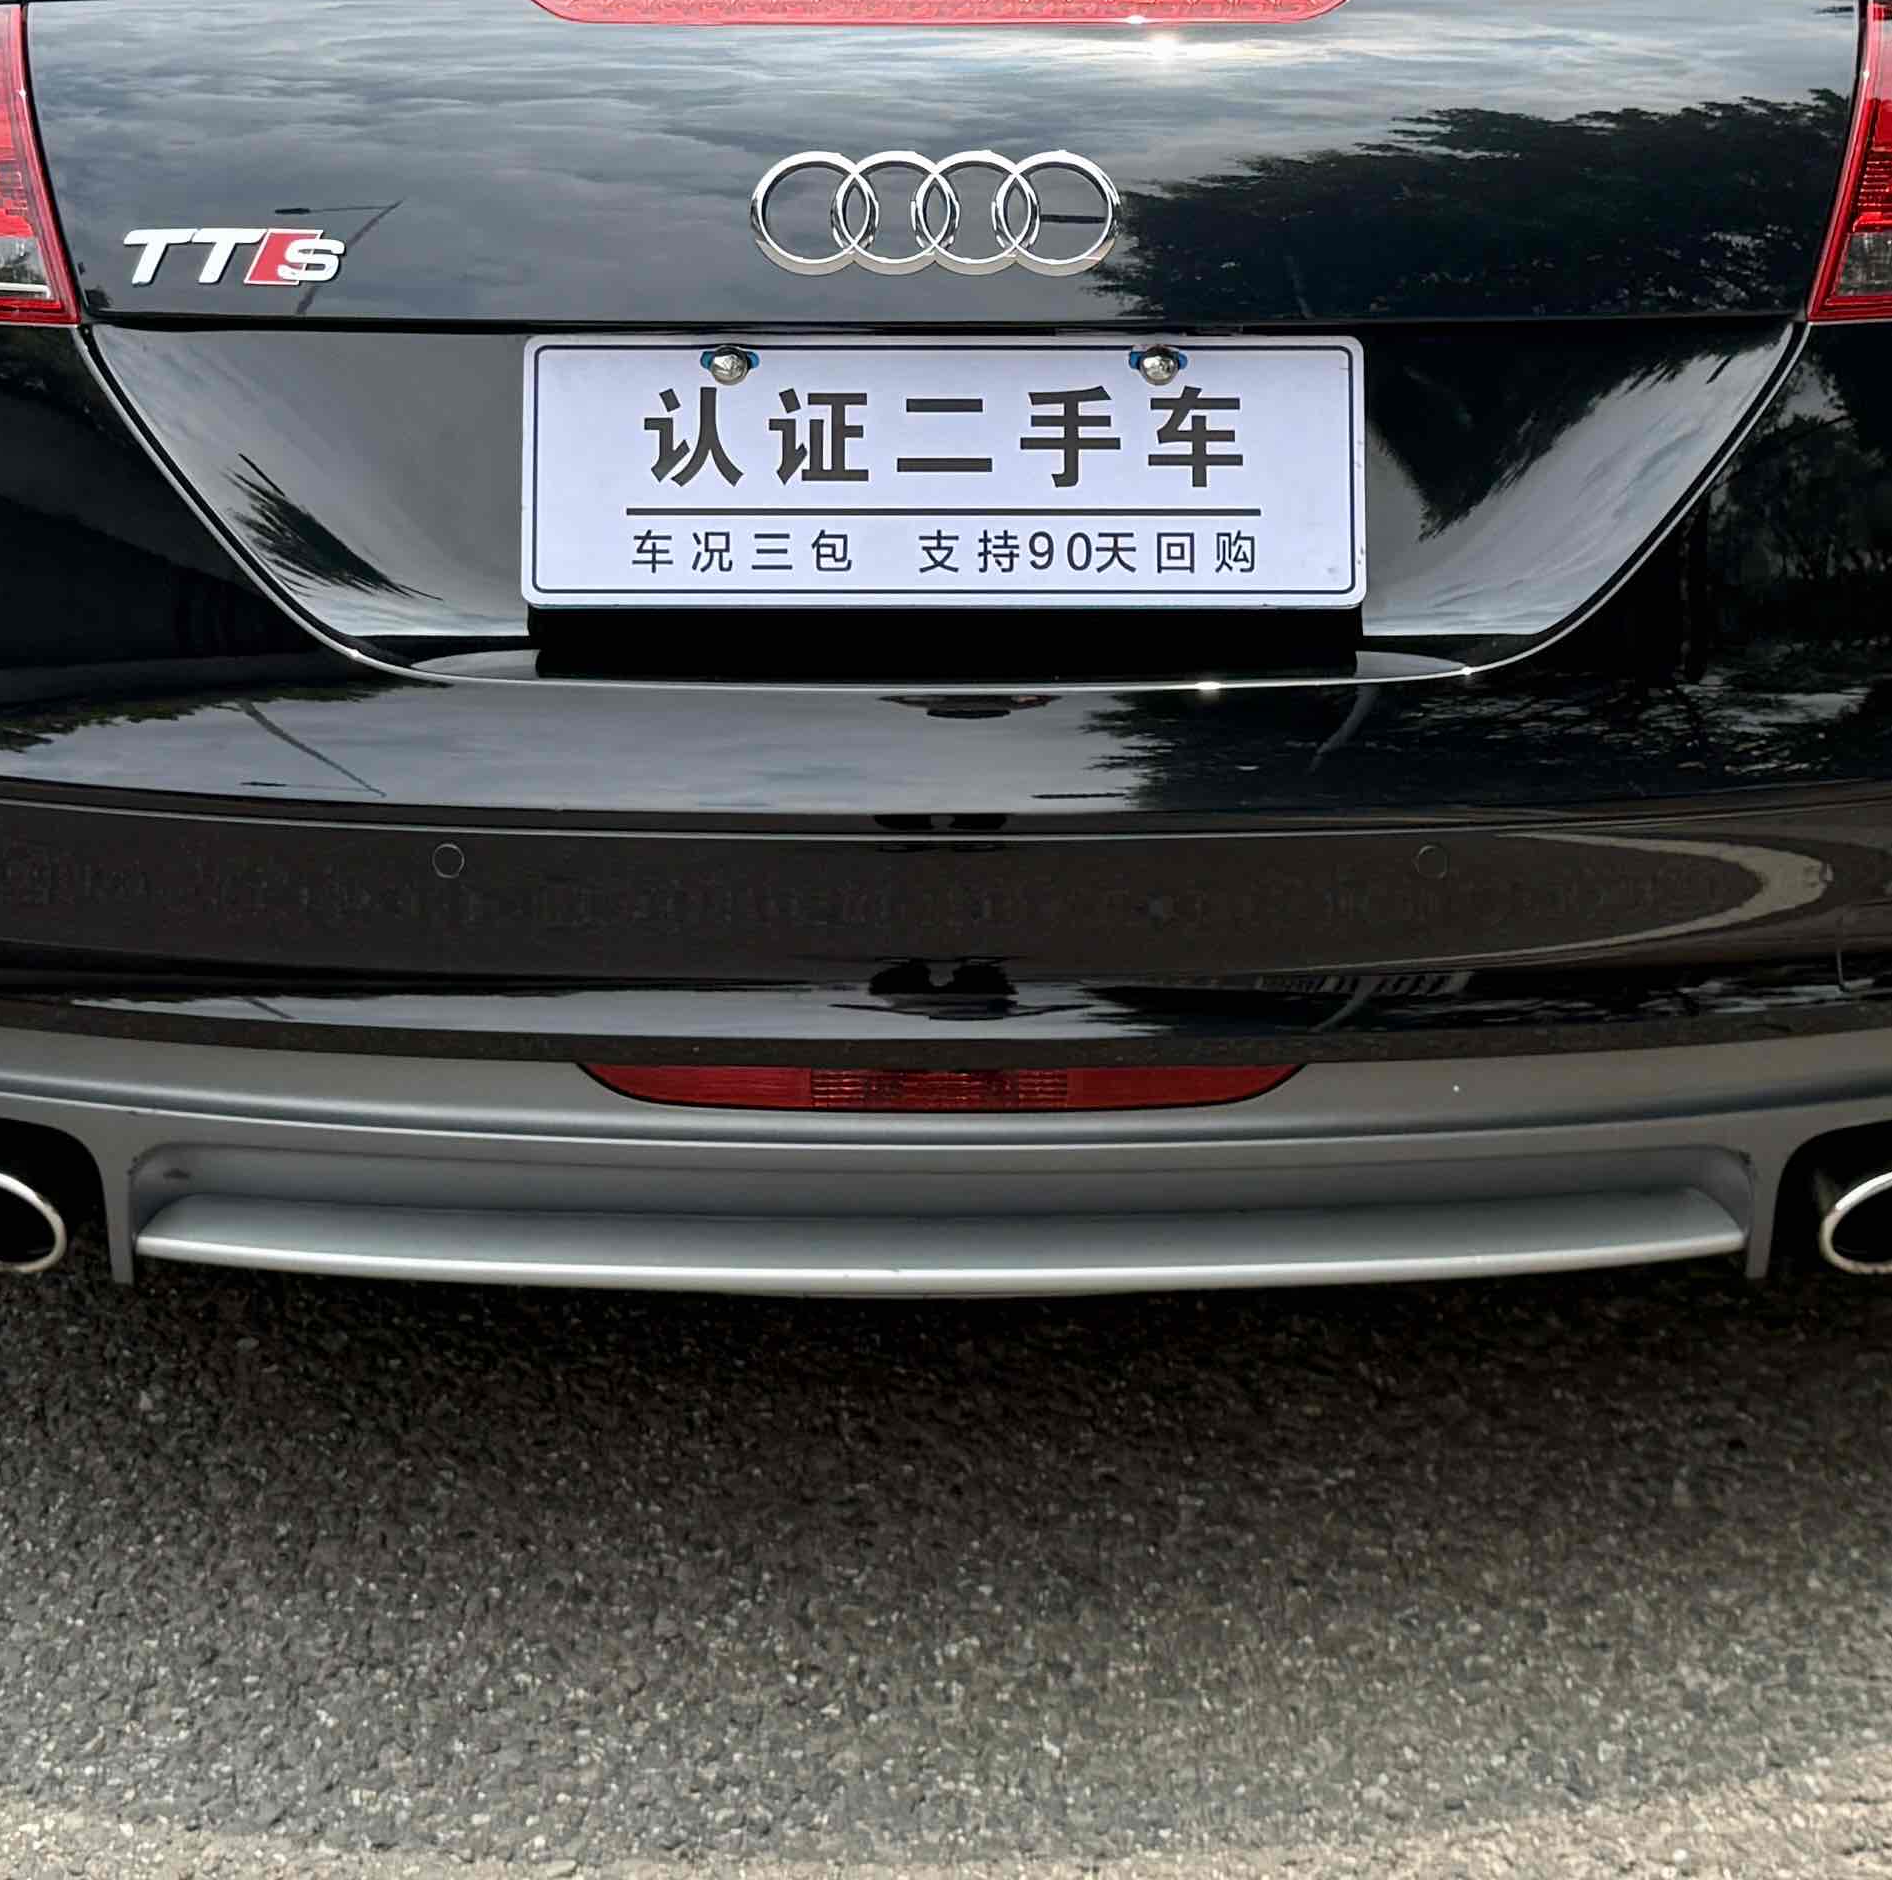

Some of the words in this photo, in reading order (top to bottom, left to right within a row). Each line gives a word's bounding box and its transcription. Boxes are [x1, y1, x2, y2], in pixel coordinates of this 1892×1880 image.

[122, 227, 346, 287] TTS
[643, 385, 1245, 489] 认证二手车
[631, 528, 853, 575] 车况三包
[918, 528, 1256, 575] 支持90天回购
